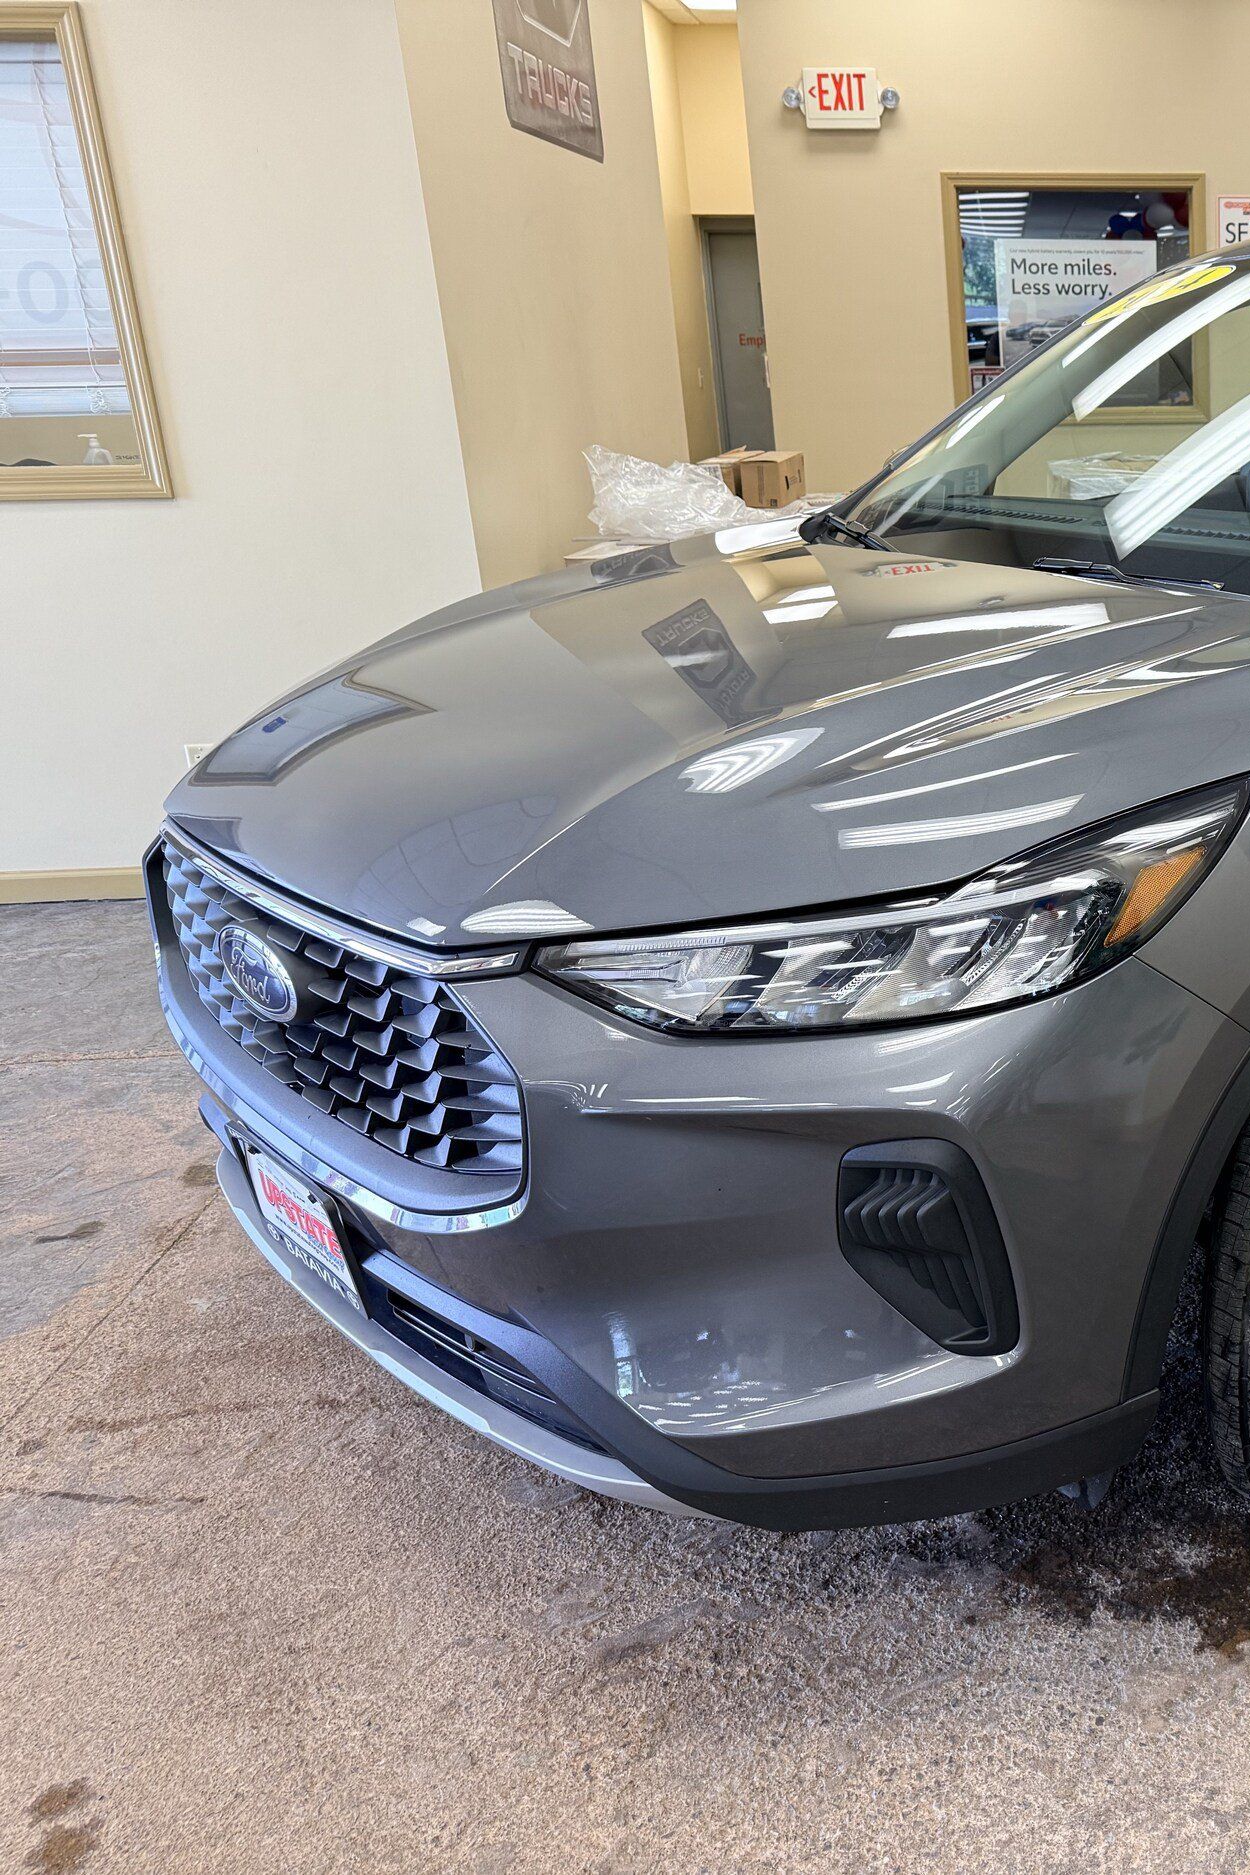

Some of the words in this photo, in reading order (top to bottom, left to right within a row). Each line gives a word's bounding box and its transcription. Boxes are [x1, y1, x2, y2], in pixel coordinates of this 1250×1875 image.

[507, 42, 594, 127] TRUCKS
[816, 73, 866, 111] EXIT
[1011, 258, 1058, 275] More
[1064, 258, 1117, 276] miles.
[1012, 278, 1050, 295] Less
[1056, 283, 1112, 300] worry.
[230, 946, 271, 1004] Ford
[258, 1168, 344, 1260] UPSTATE
[284, 1239, 346, 1298] BATAVIA
